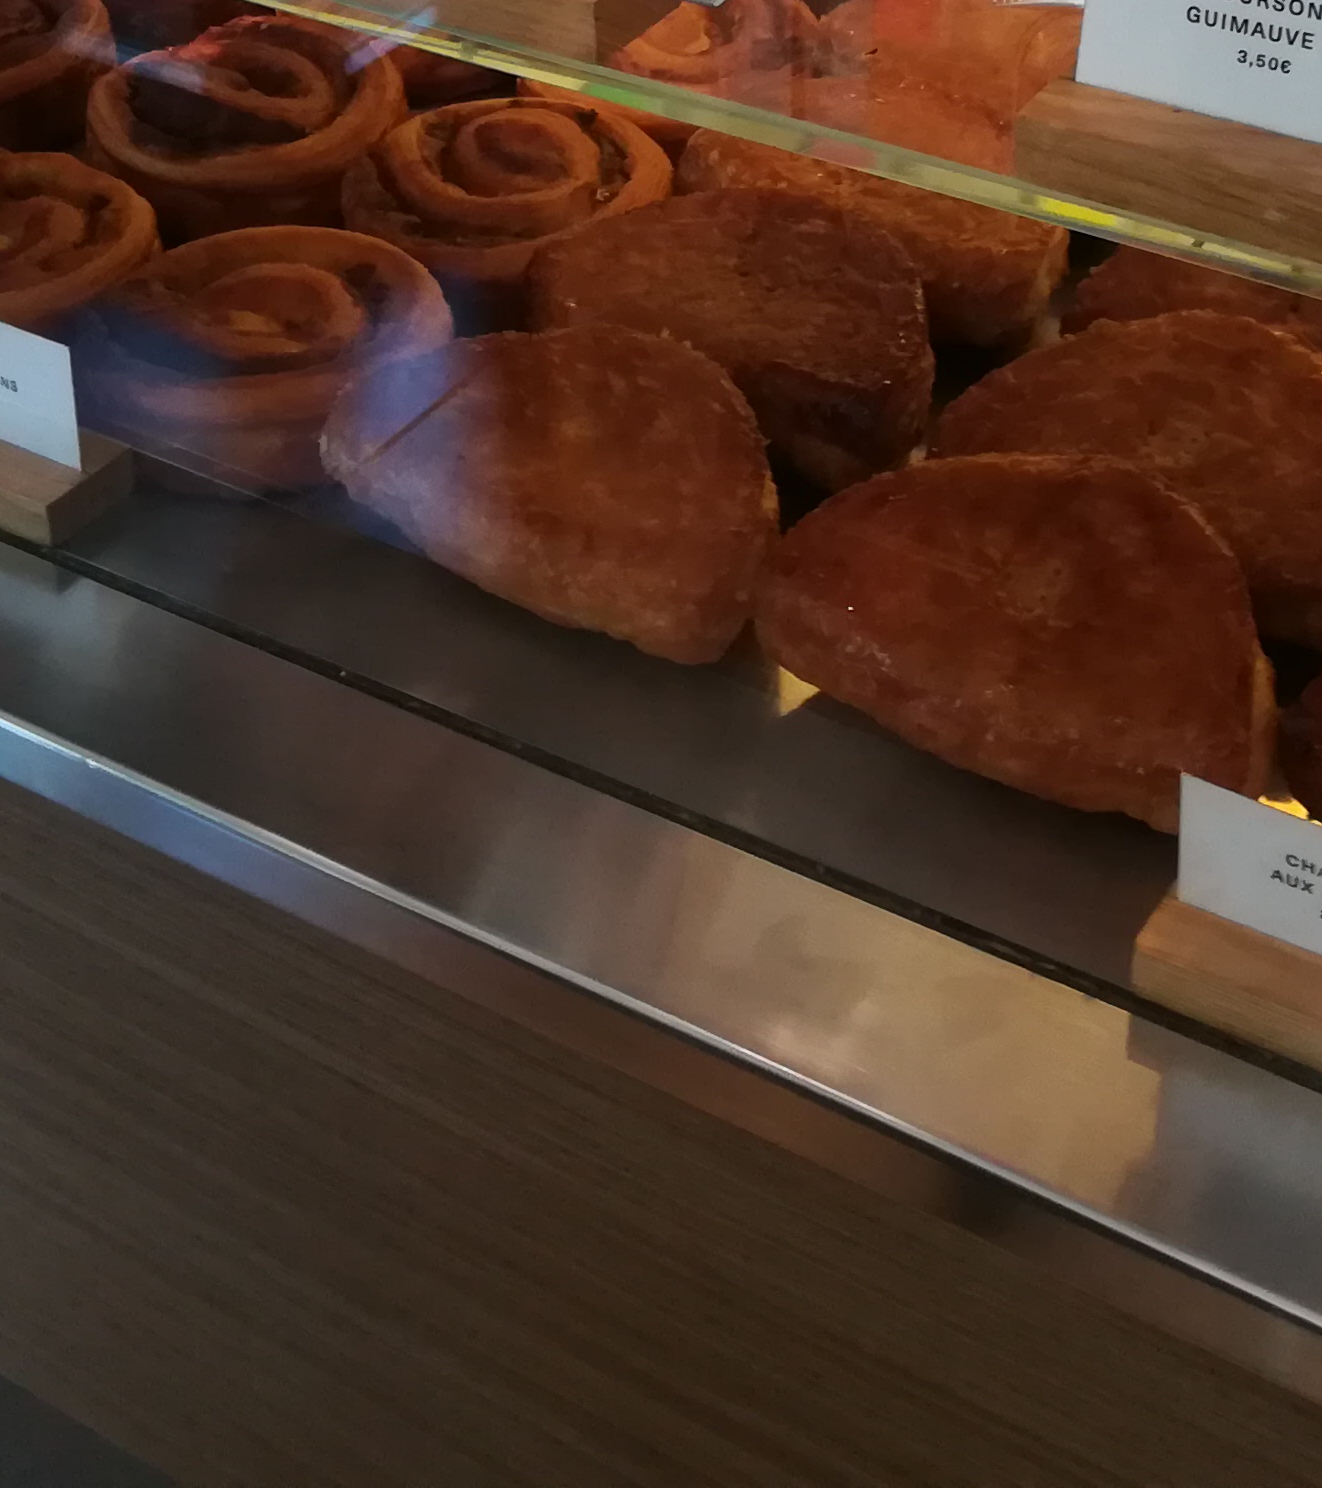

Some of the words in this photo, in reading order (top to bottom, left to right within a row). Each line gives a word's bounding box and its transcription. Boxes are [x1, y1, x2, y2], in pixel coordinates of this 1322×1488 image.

[1186, 6, 1314, 50] GUIMAUVE
[1237, 50, 1292, 74] 3,50€
[1270, 870, 1315, 894] AUX
